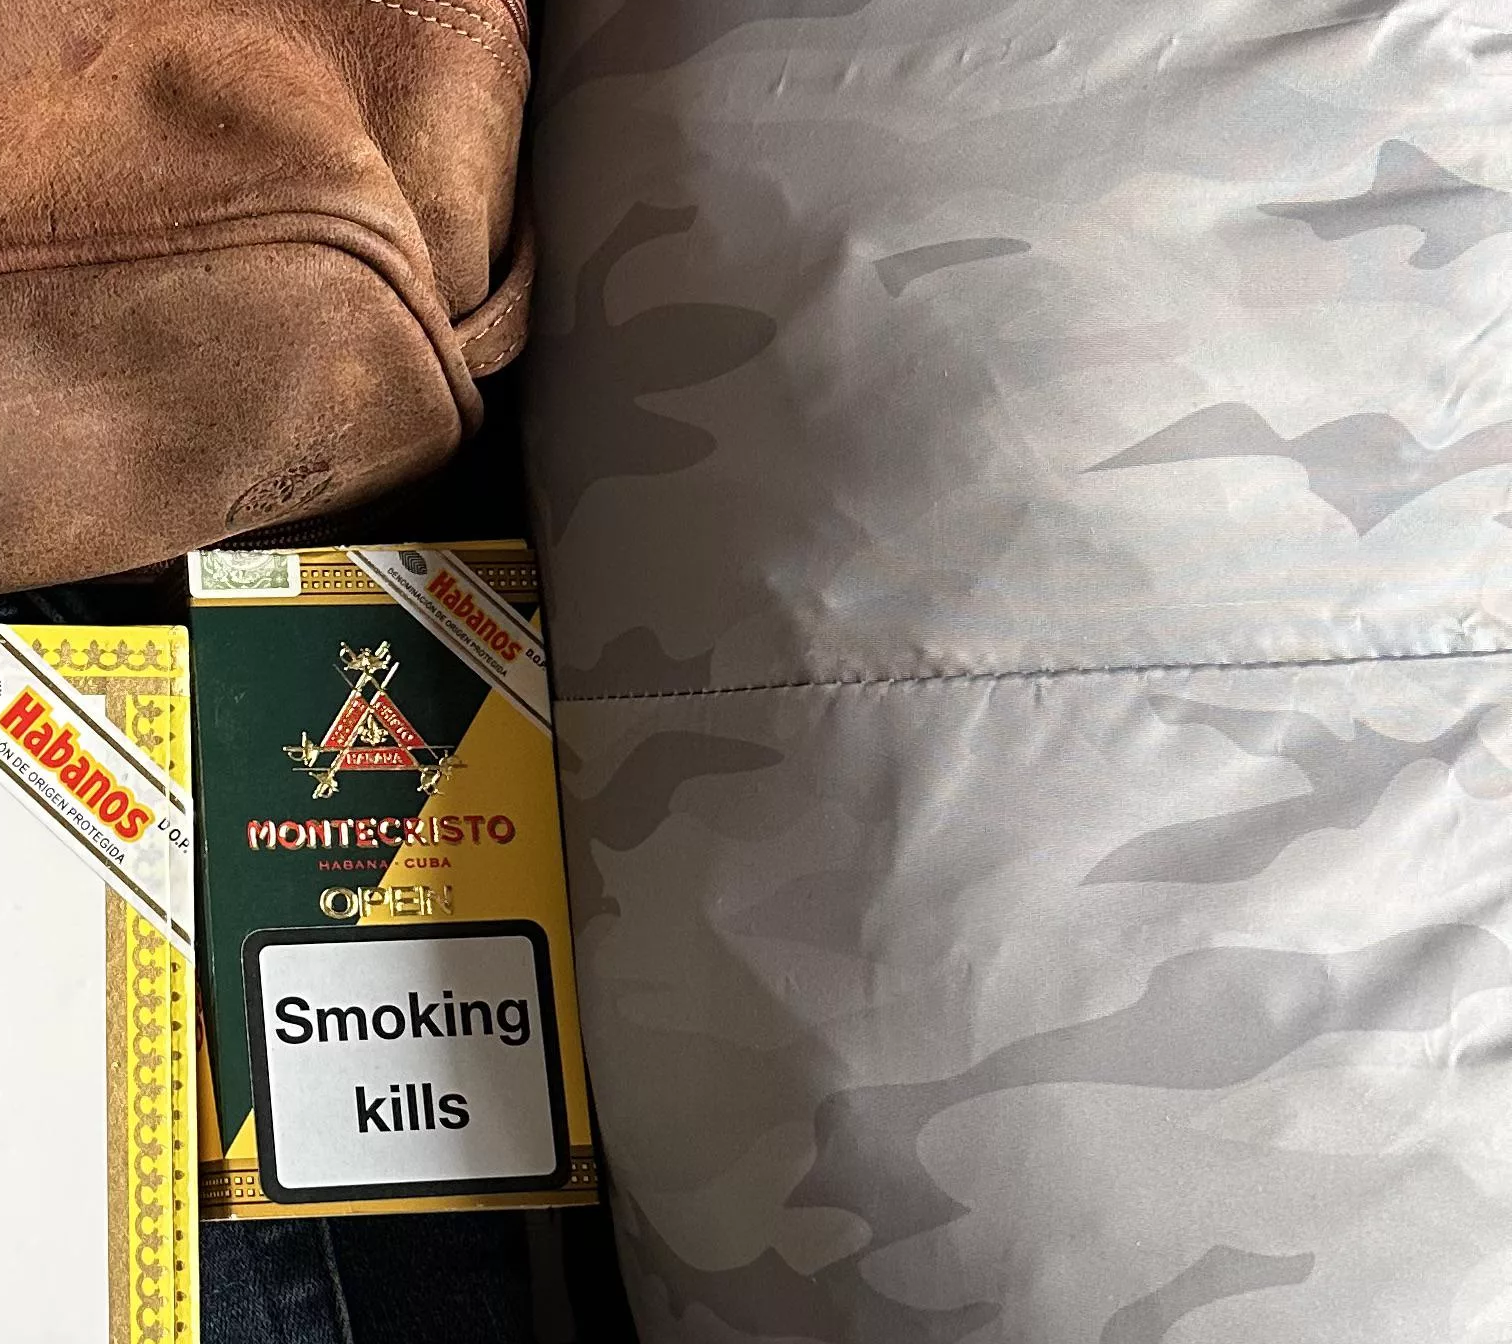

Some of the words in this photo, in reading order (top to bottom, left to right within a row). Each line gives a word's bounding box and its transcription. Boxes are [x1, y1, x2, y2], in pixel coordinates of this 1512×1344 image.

[426, 568, 524, 662] Habanos
[436, 610, 447, 623] DE
[445, 619, 471, 648] ORIGEN
[469, 642, 508, 678] PROTEGIDA
[11, 756, 30, 775] DE
[28, 772, 70, 811] ORIGEN
[66, 806, 126, 865] PROTEGIDA
[247, 815, 516, 850] MONTECRISTO
[319, 860, 389, 871] HABANA
[404, 858, 452, 869] CUBA
[319, 885, 454, 920] OPEN
[275, 991, 531, 1047] Smoking
[355, 1082, 471, 1134] kills
